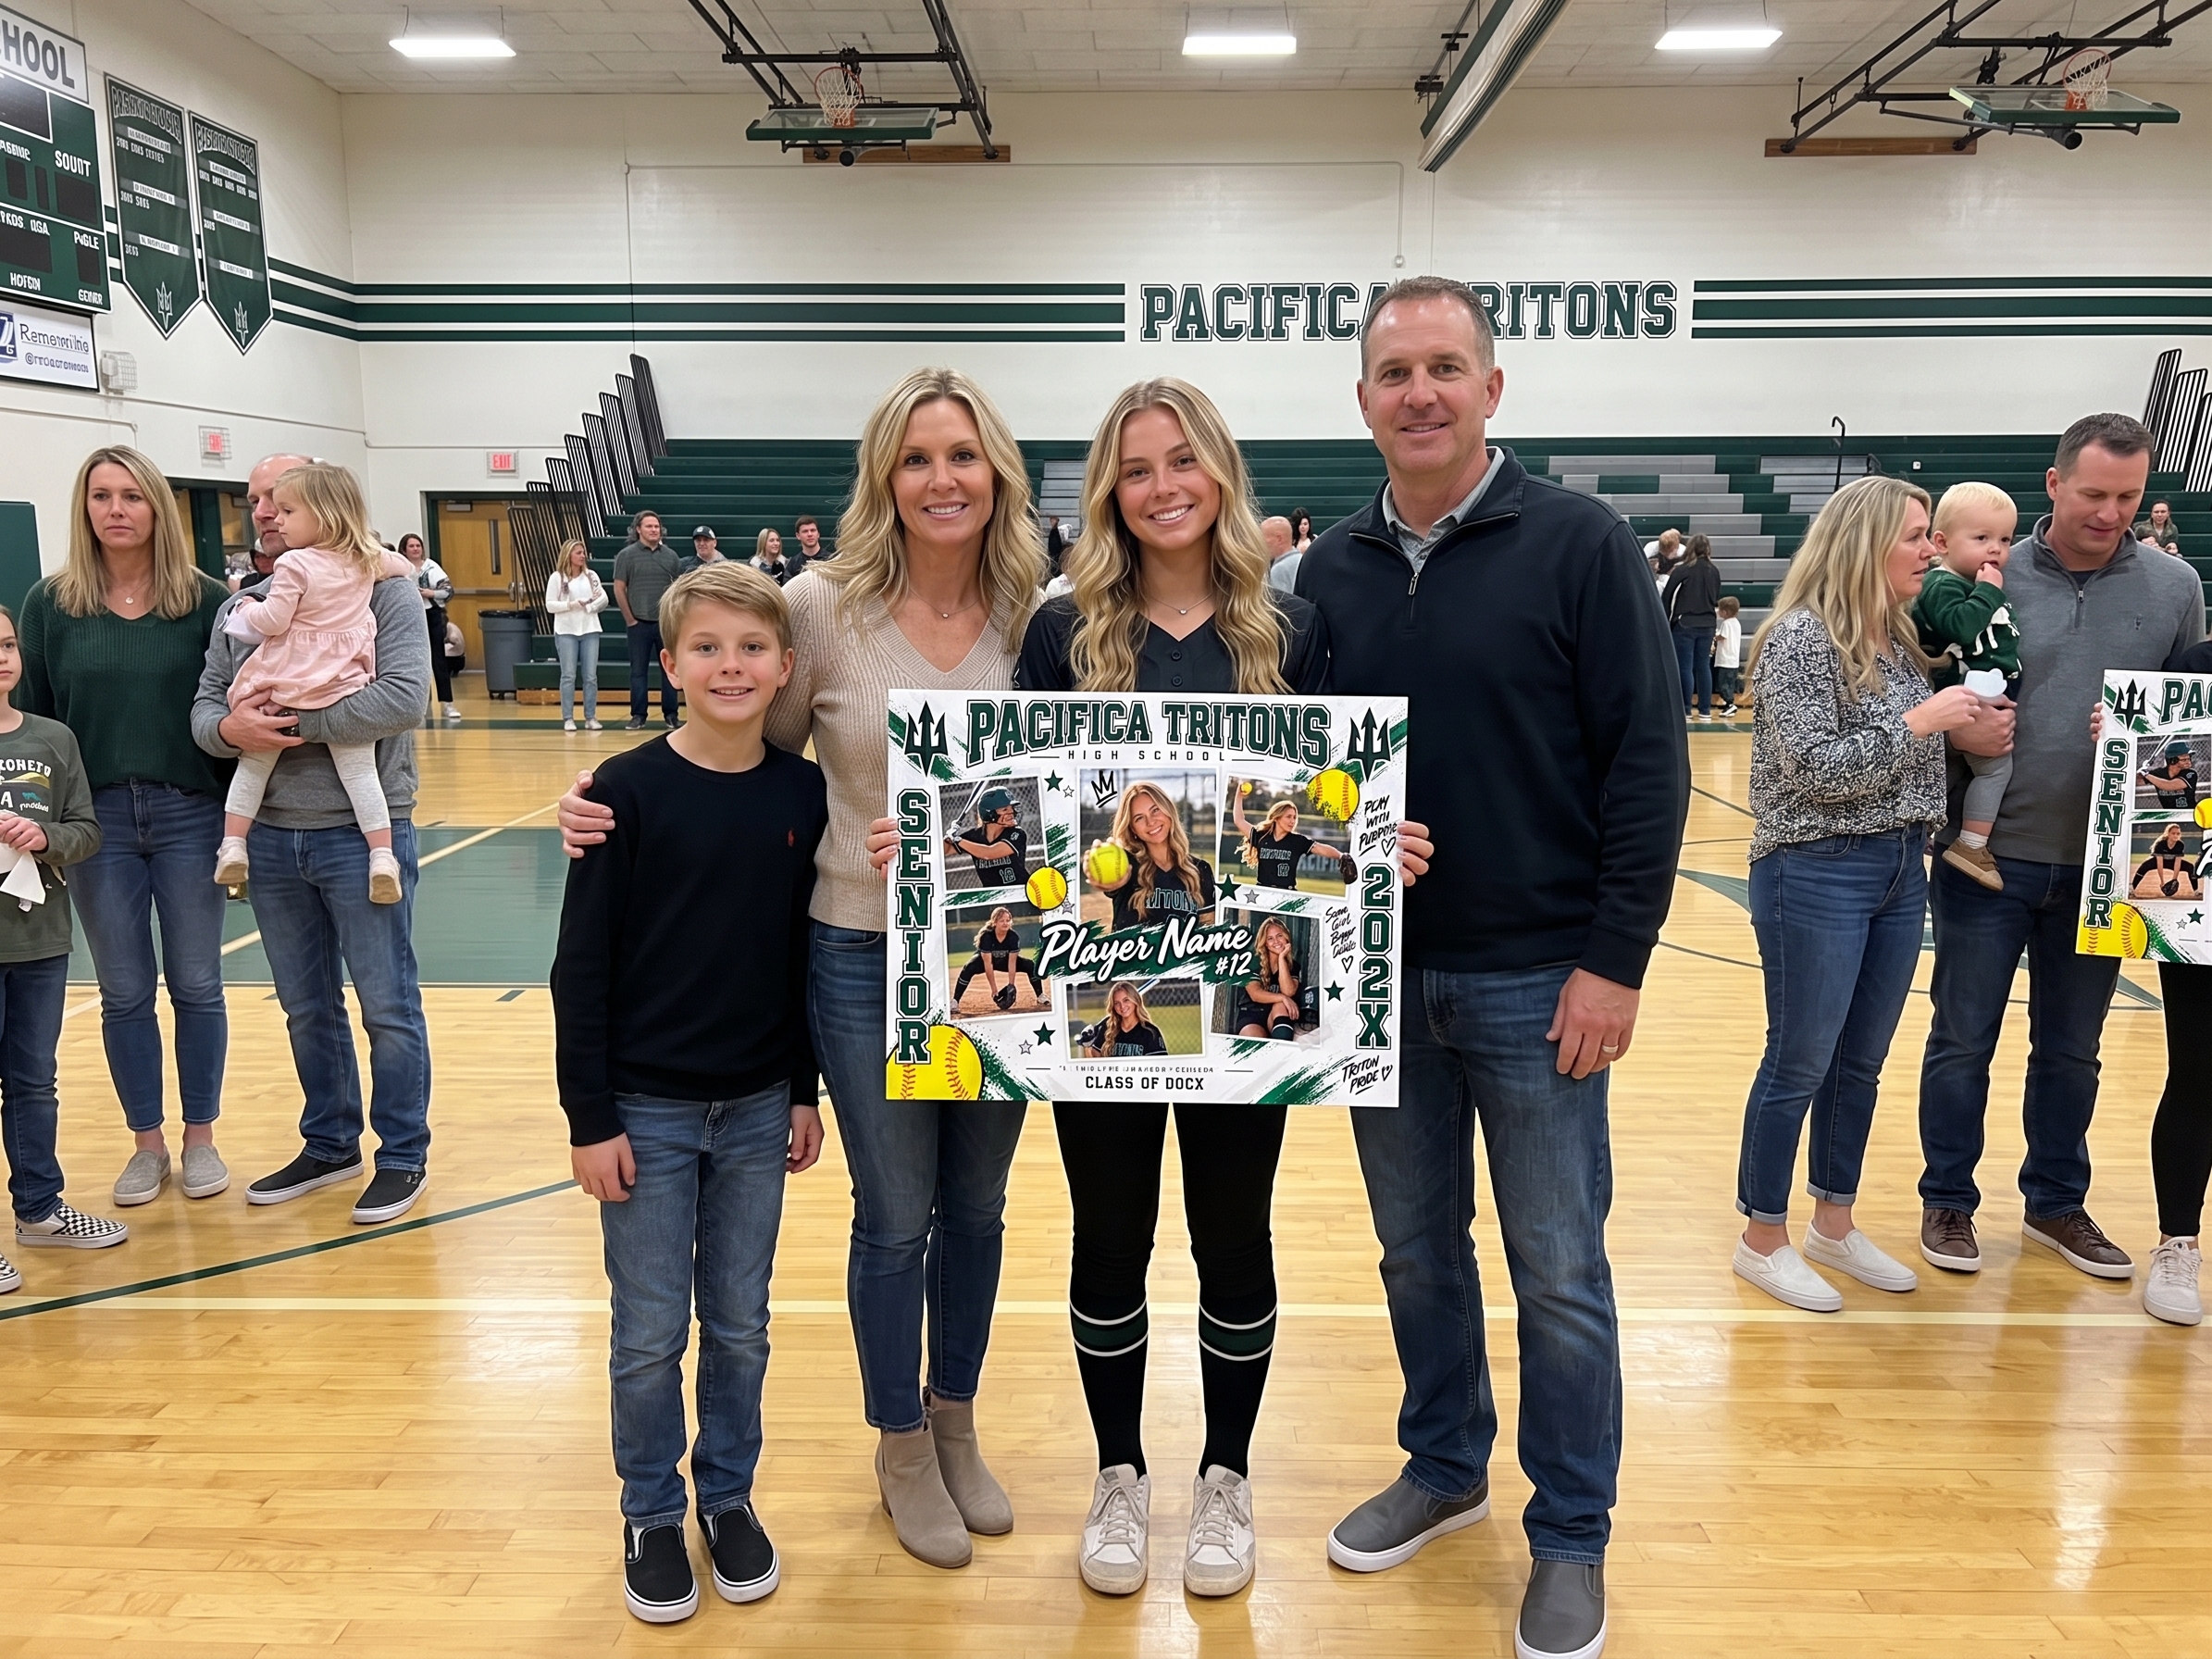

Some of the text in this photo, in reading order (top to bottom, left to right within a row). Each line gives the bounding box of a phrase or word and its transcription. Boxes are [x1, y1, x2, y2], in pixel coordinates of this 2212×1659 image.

[0, 19, 75, 89] HOOL
[1467, 281, 1676, 341] RITONS
[966, 699, 1332, 770] PACIFICA TRITONS
[1068, 751, 1225, 761] HIGH SCHOOL
[2084, 738, 2129, 929] SENIOR
[895, 789, 934, 1065] SENIOR
[1037, 916, 1253, 981] Player Name
[1356, 863, 1395, 1050] 202X
[1214, 951, 1253, 978] #12
[1085, 1076, 1205, 1091] CLASS OF DOCX
